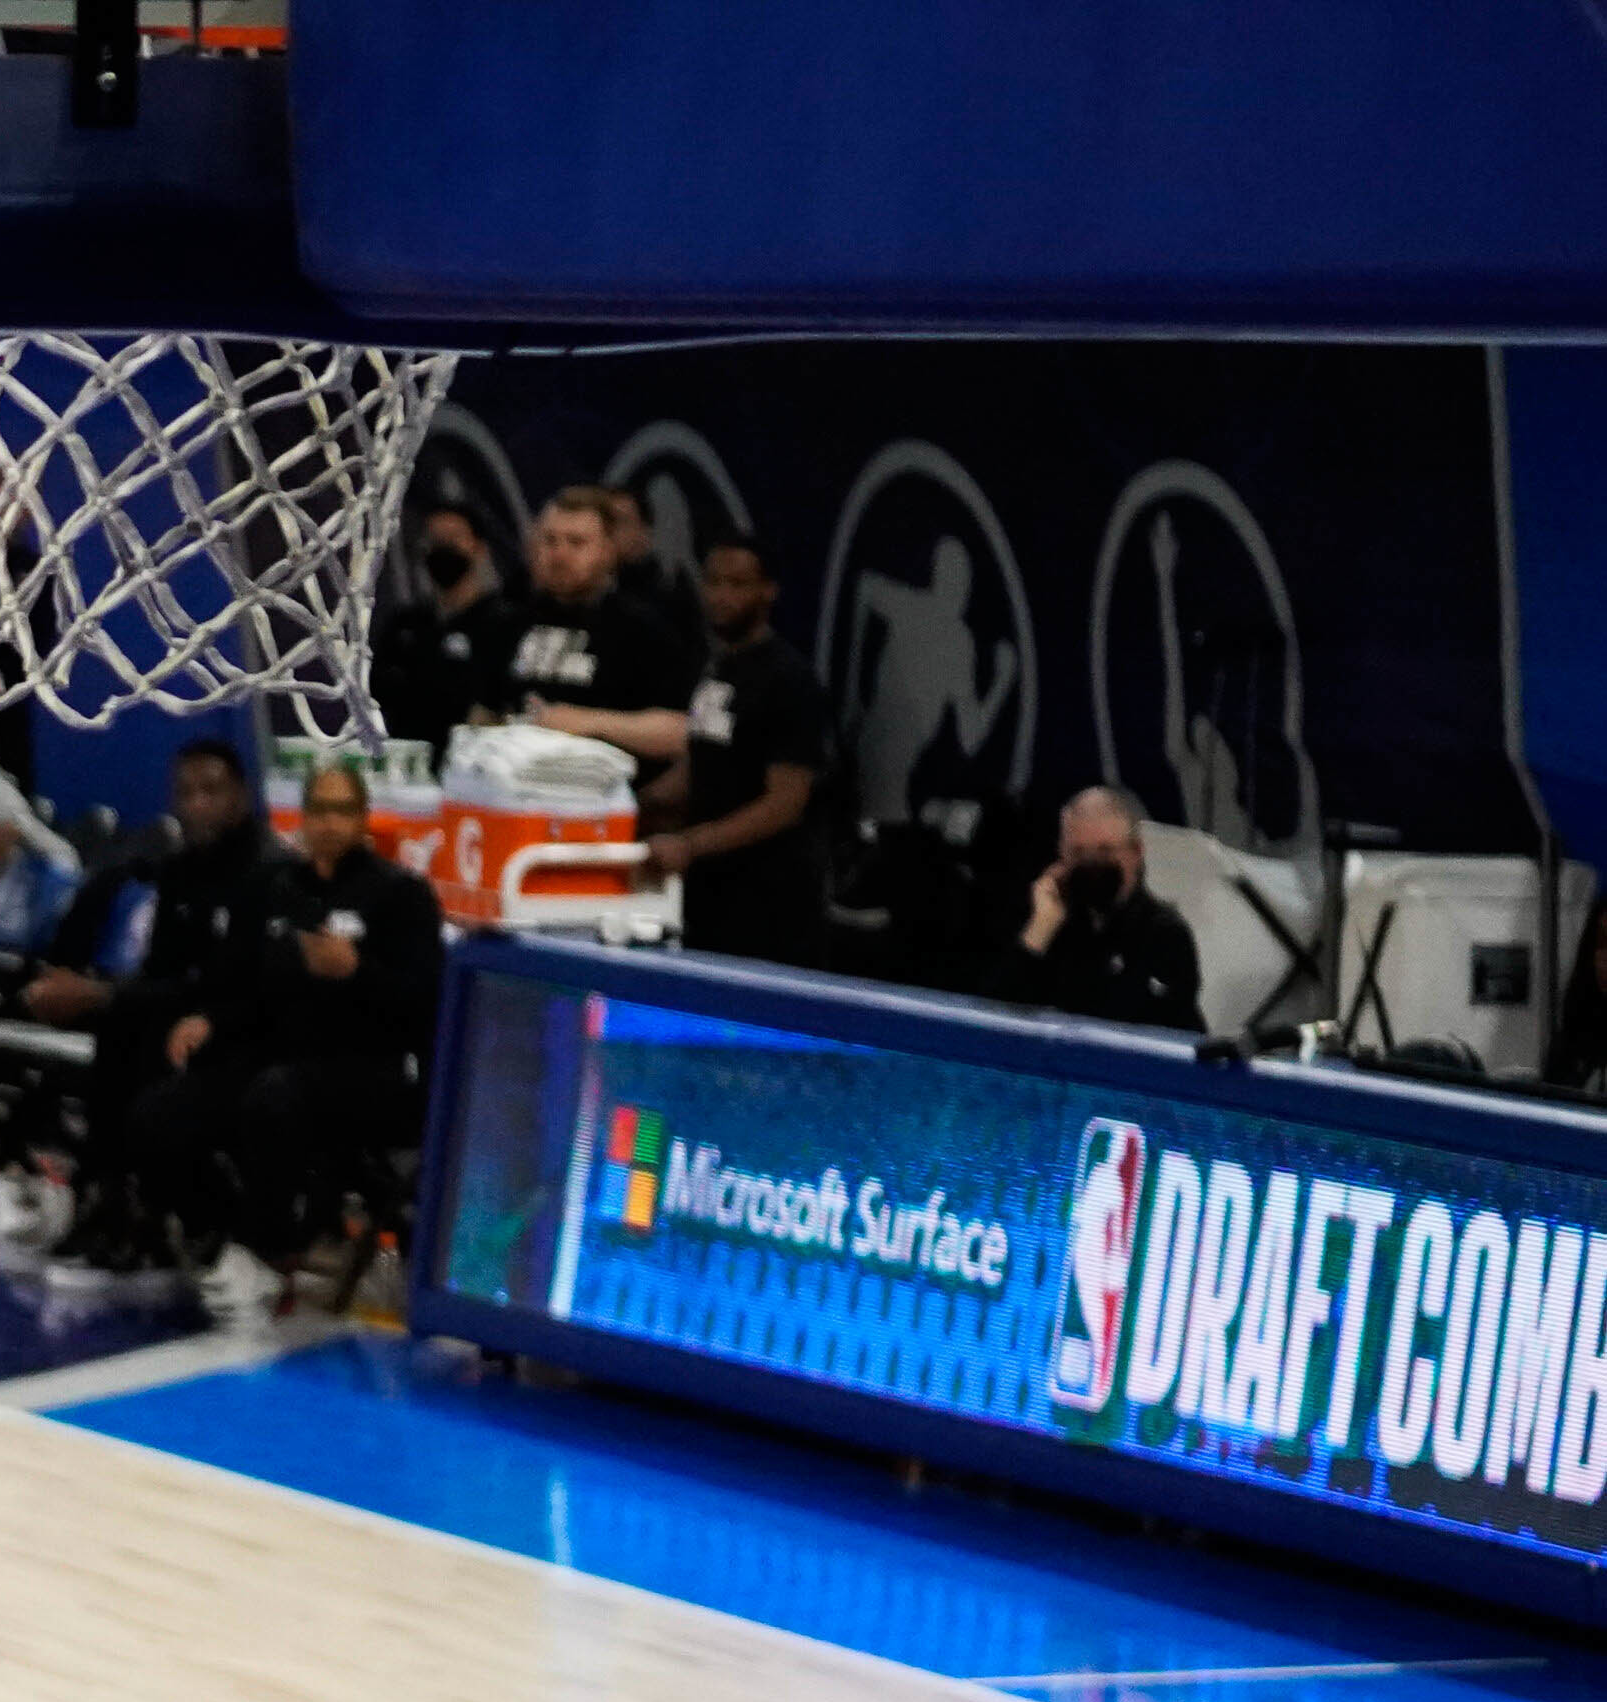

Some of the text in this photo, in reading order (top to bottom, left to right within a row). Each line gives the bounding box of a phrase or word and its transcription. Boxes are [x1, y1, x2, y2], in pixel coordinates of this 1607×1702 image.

[663, 1135, 1009, 1287] Microsoft Surface
[1125, 1149, 1397, 1448] DRAFT
